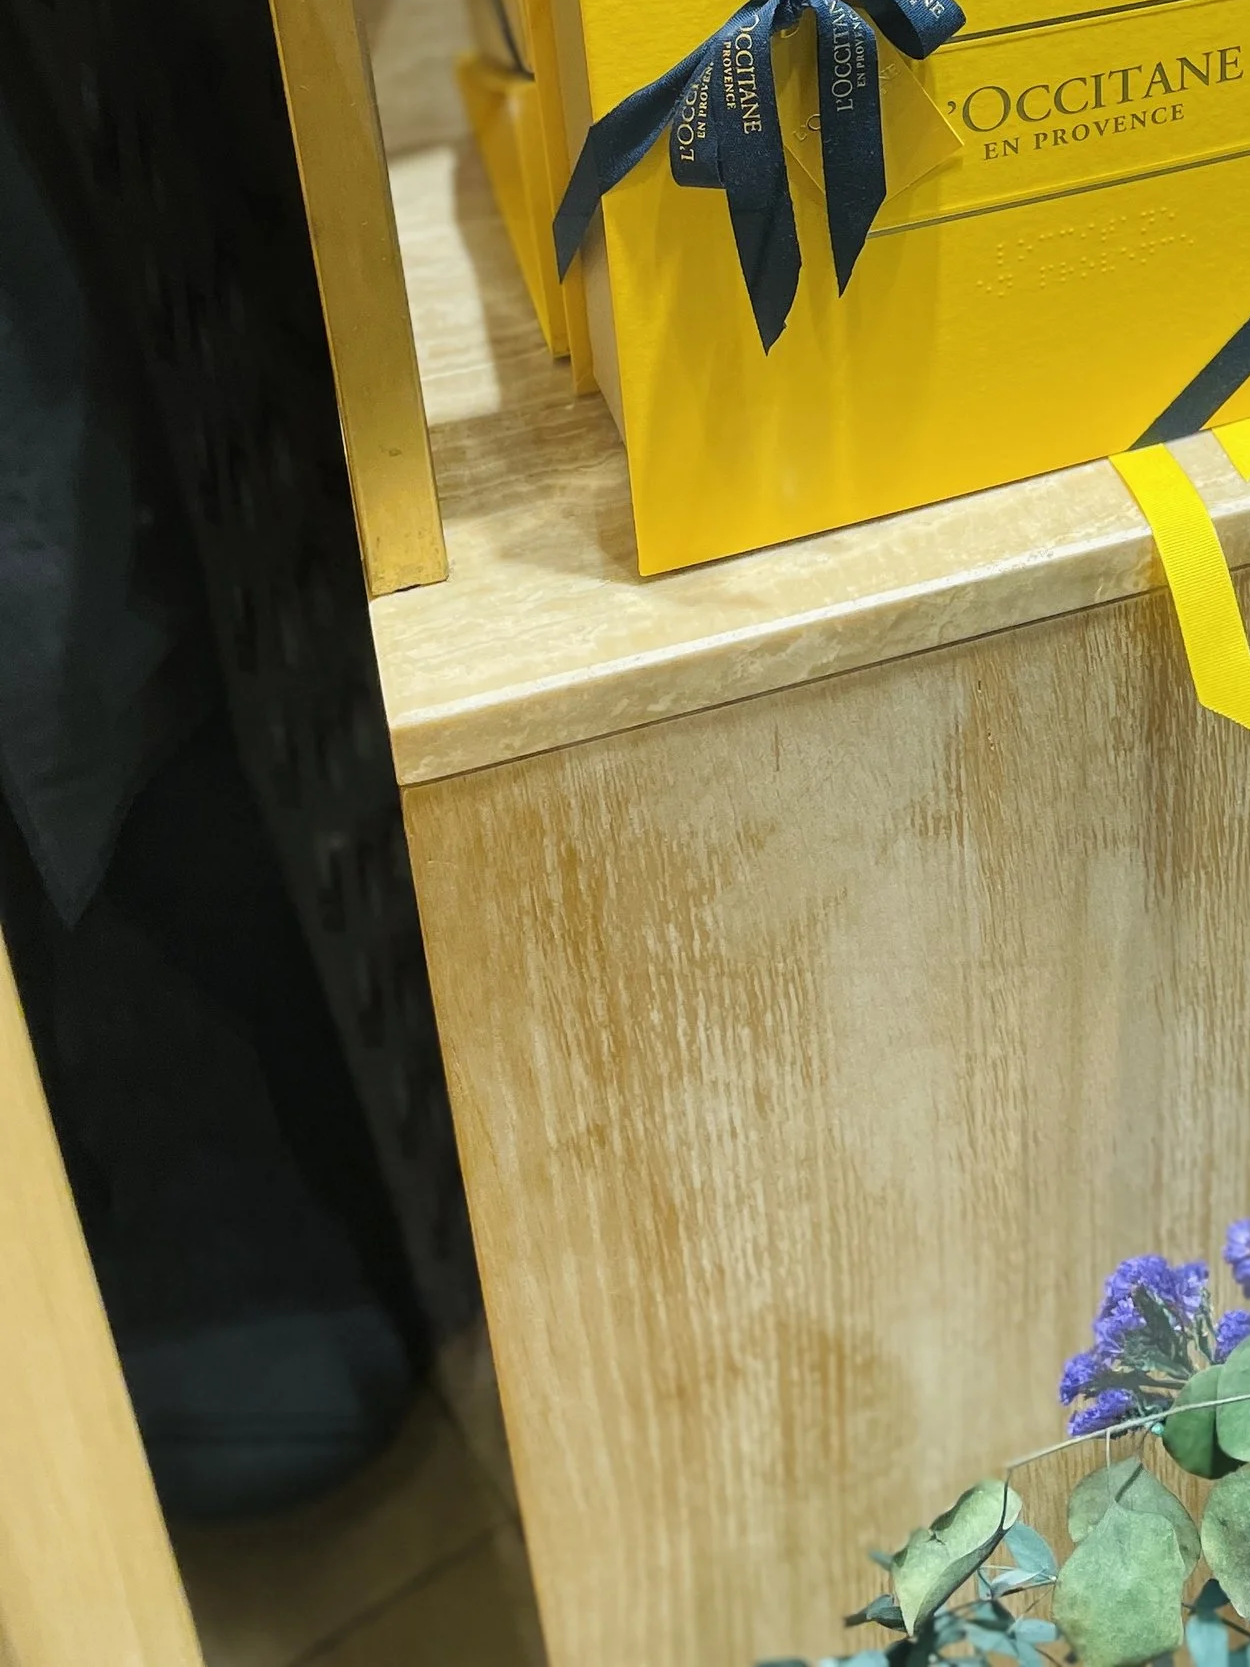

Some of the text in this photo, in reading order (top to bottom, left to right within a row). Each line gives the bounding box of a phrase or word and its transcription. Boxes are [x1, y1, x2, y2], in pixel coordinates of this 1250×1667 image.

[722, 42, 736, 110] PROVENCE
[829, 0, 853, 111] L'OCCITAN
[857, 72, 865, 87] EN
[947, 45, 1244, 133] 'OCCITANE
[983, 104, 1185, 161] EN PROVENCE
